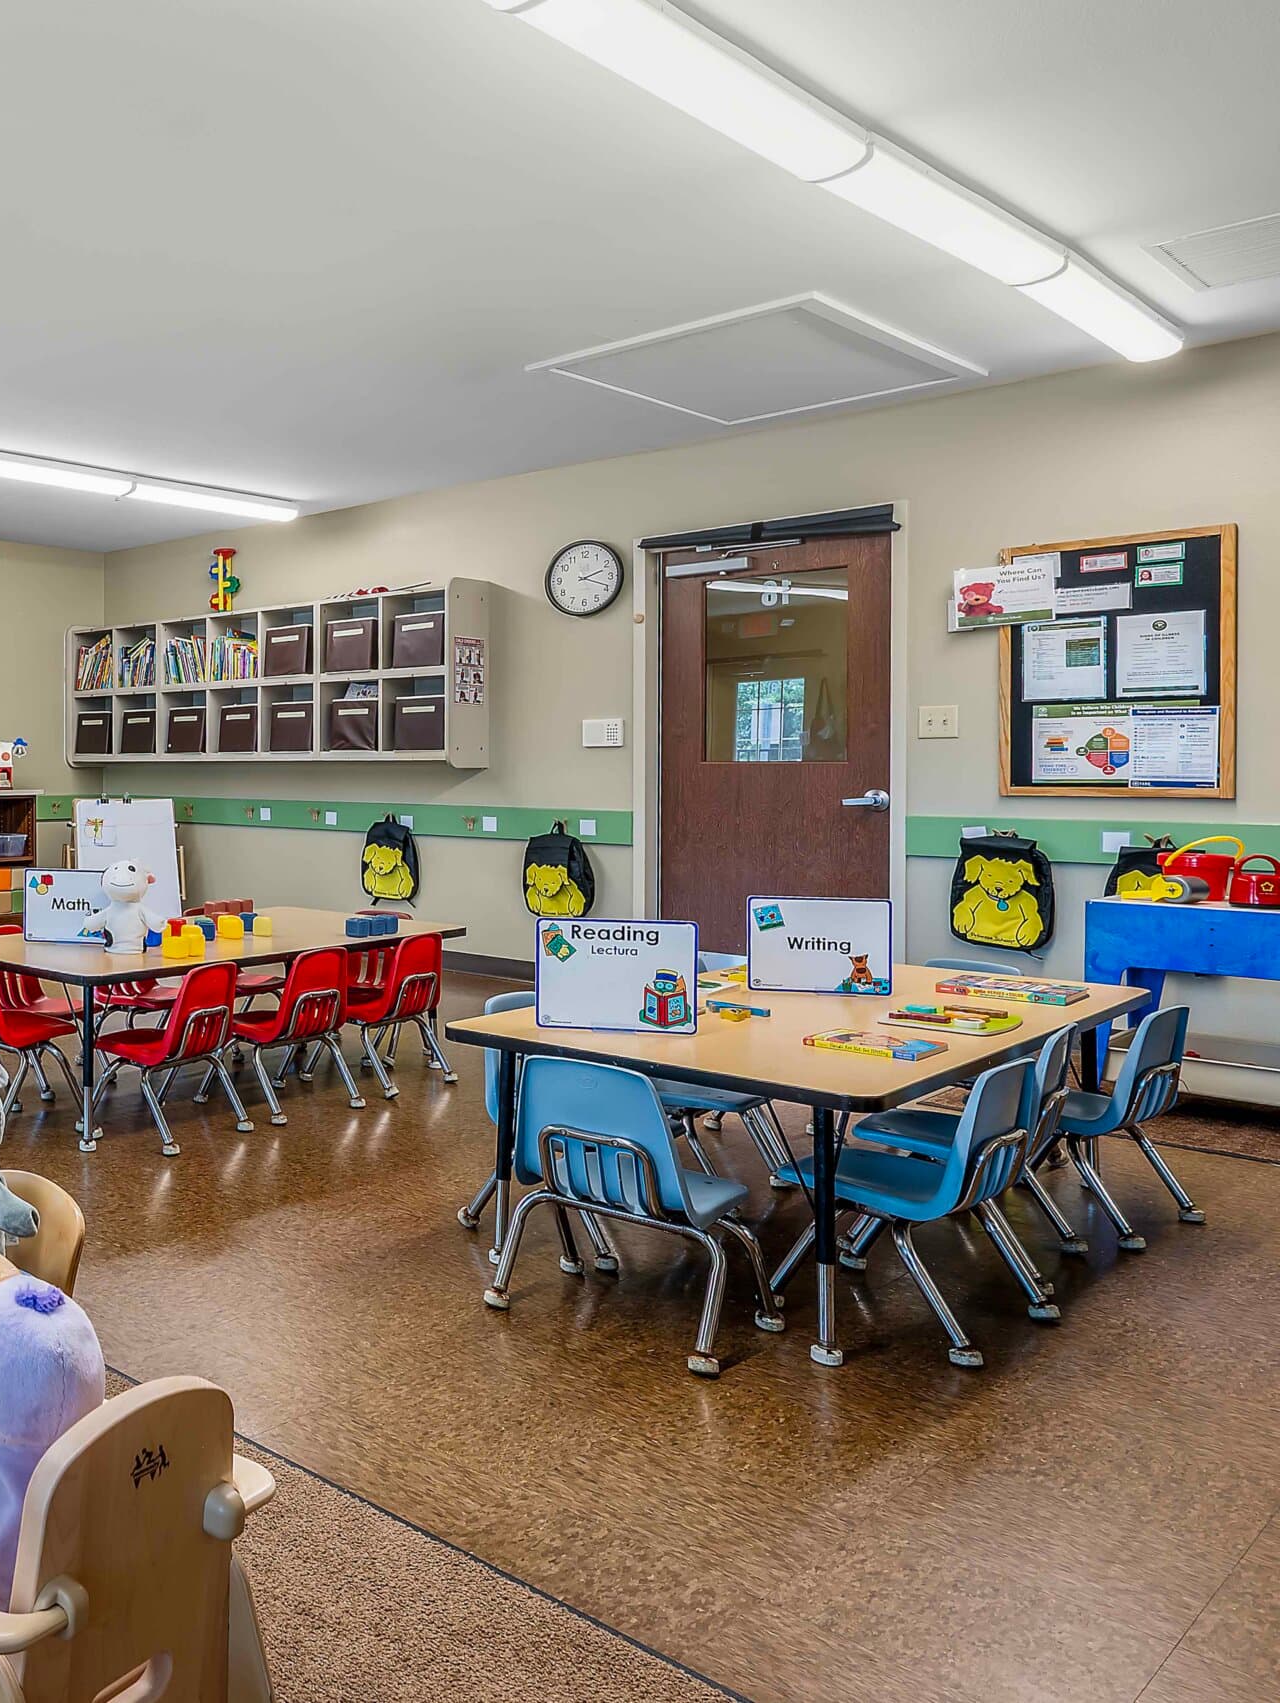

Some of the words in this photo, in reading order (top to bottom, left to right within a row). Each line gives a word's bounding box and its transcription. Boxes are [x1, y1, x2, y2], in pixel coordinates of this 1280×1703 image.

[581, 550, 590, 559] 12
[569, 556, 576, 564] 11
[603, 559, 610, 568] 2
[561, 564, 569, 572] 10
[607, 572, 614, 580] 3
[999, 569, 1025, 577] Where
[556, 577, 563, 586] 9
[1012, 575, 1030, 583] Find
[1031, 573, 1047, 581] Us?
[560, 589, 566, 597] 8
[570, 596, 576, 605] 7
[581, 599, 588, 607] 6
[593, 594, 600, 603] 5
[51, 897, 91, 911] Math
[571, 924, 660, 946] Reading
[591, 944, 639, 956] Lectura
[787, 936, 852, 955] Writing
